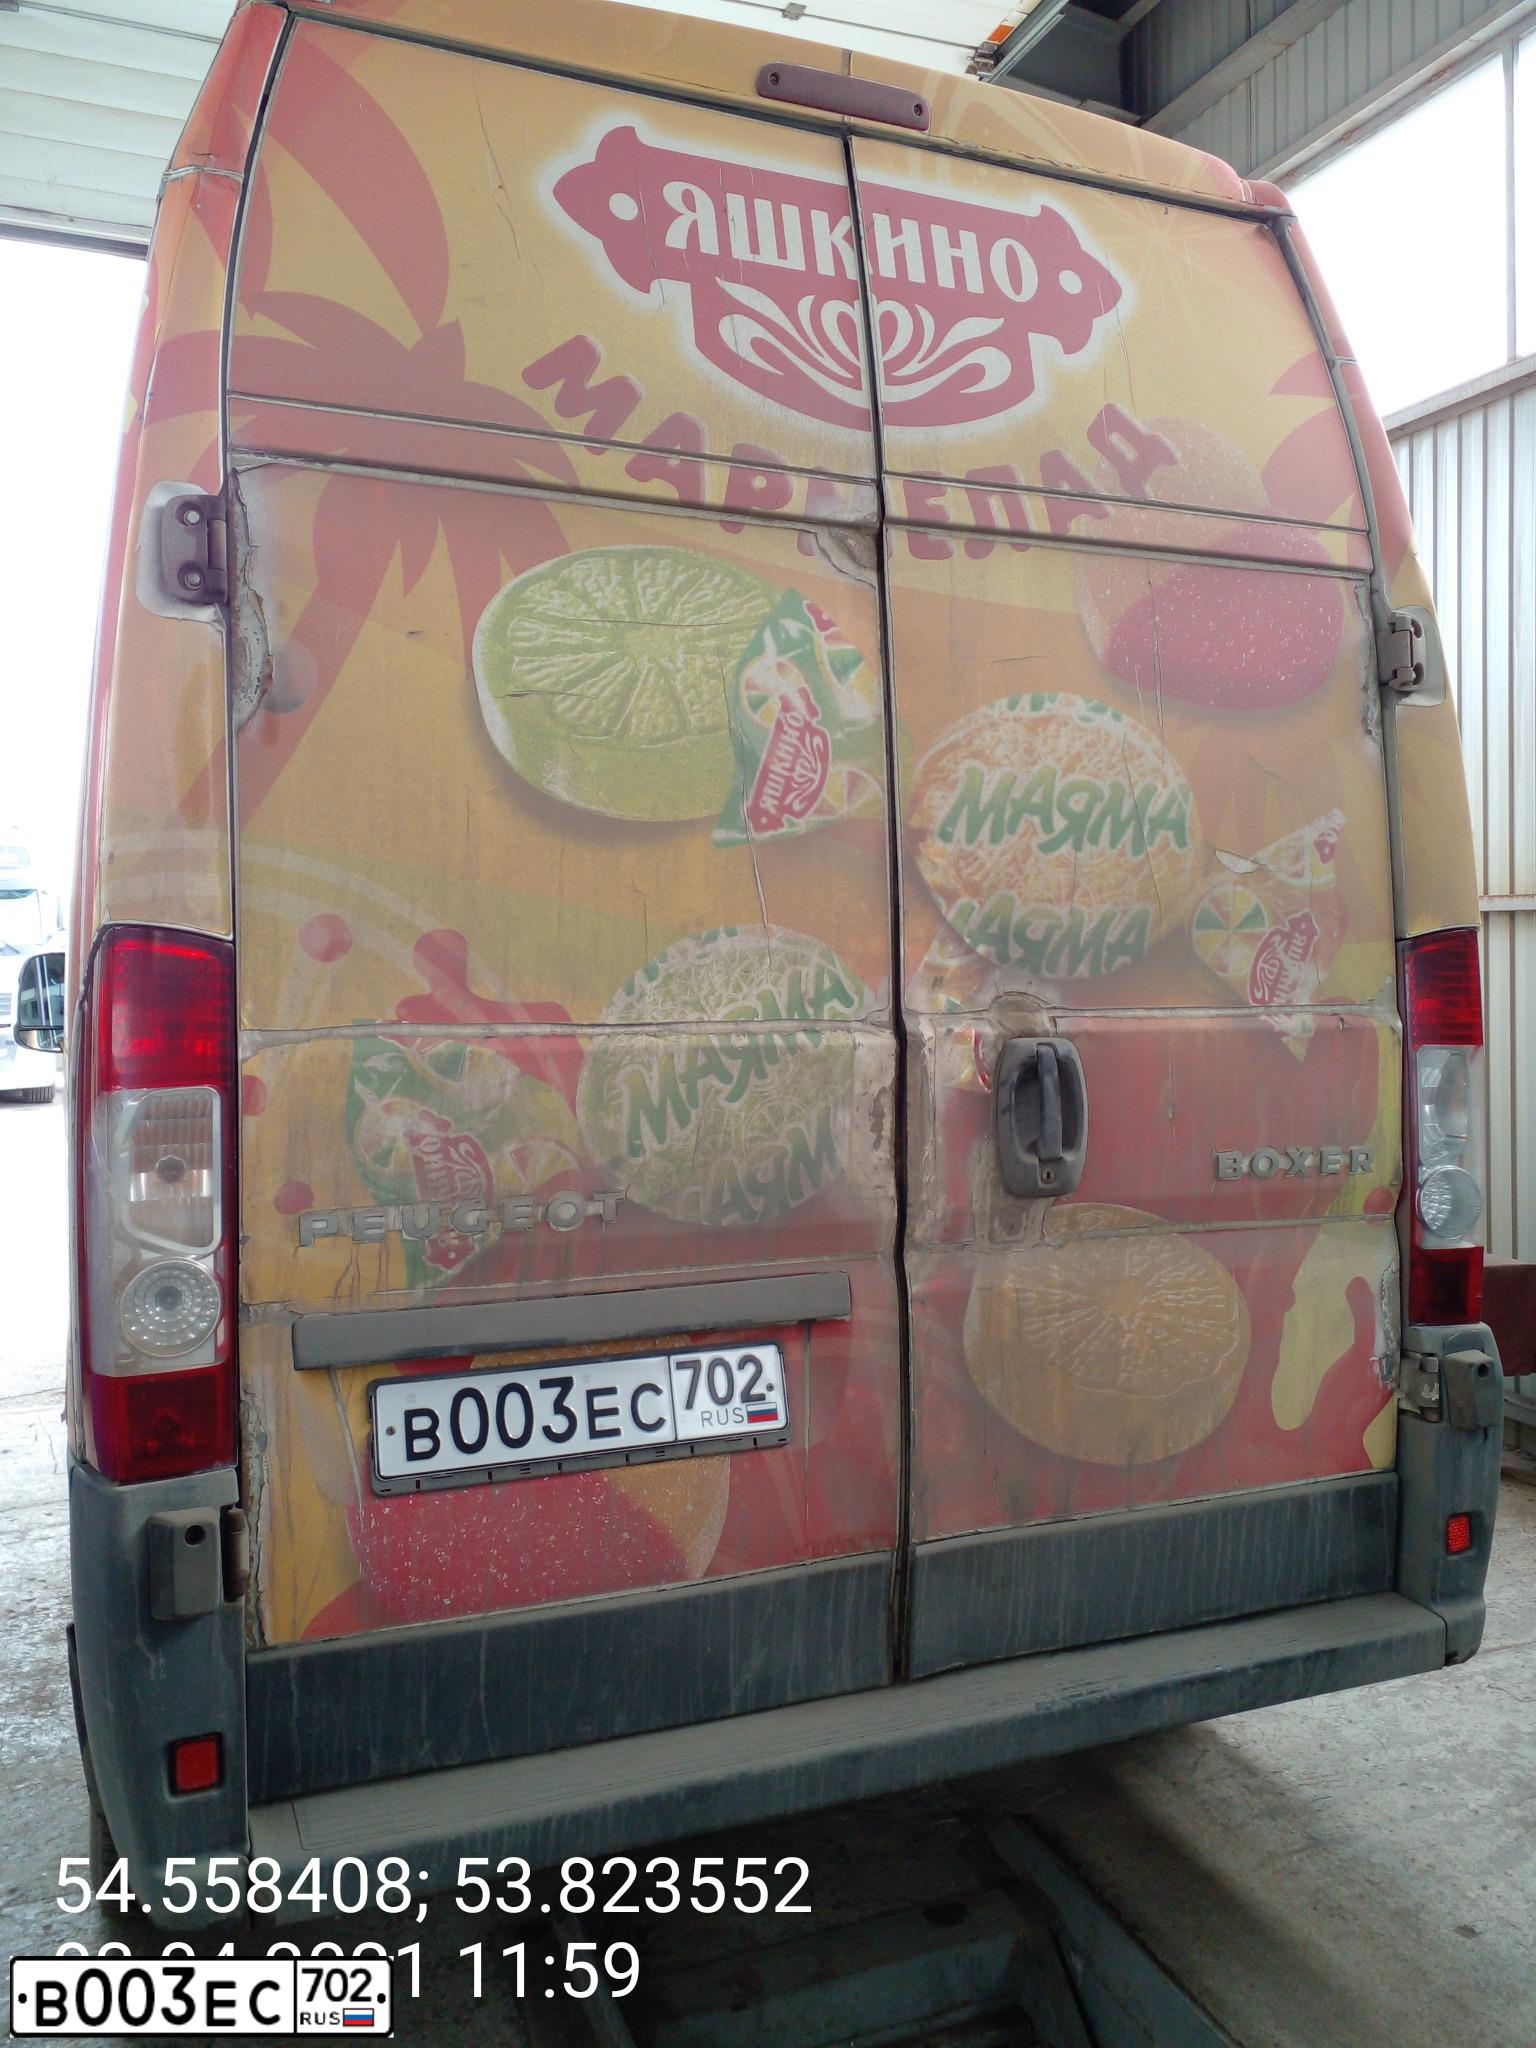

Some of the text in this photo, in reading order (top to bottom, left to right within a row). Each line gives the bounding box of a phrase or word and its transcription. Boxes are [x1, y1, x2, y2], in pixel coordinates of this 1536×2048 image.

[662, 180, 1039, 303] ЯШКИНО
[938, 765, 1190, 858] МАЯМА
[1215, 1145, 1376, 1181] BOXER
[299, 1190, 627, 1248] PEUGEOT
[675, 1354, 767, 1411] 702
[700, 1405, 745, 1428] RUS
